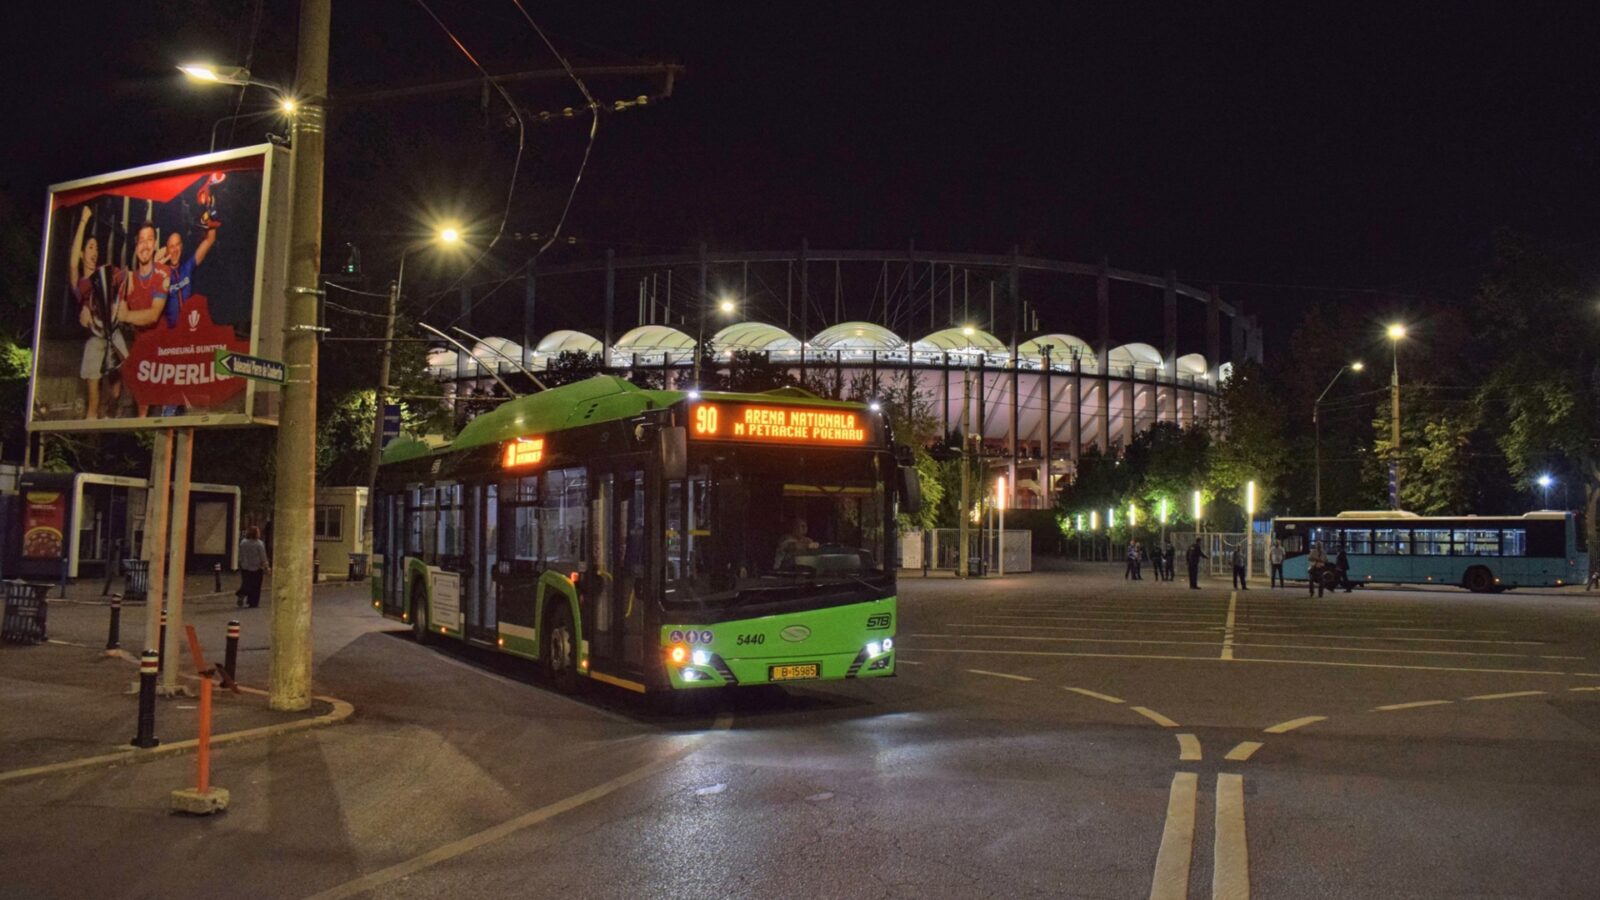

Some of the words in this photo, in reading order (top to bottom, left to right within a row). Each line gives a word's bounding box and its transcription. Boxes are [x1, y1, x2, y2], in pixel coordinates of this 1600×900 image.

[696, 406, 718, 434] 90
[745, 409, 785, 426] ARENA
[790, 411, 855, 428] NATIONALA
[734, 422, 745, 435] M
[748, 424, 809, 438] PETRACHE
[812, 427, 864, 441] POENARU
[866, 614, 891, 629] STB
[736, 633, 766, 646] 5440
